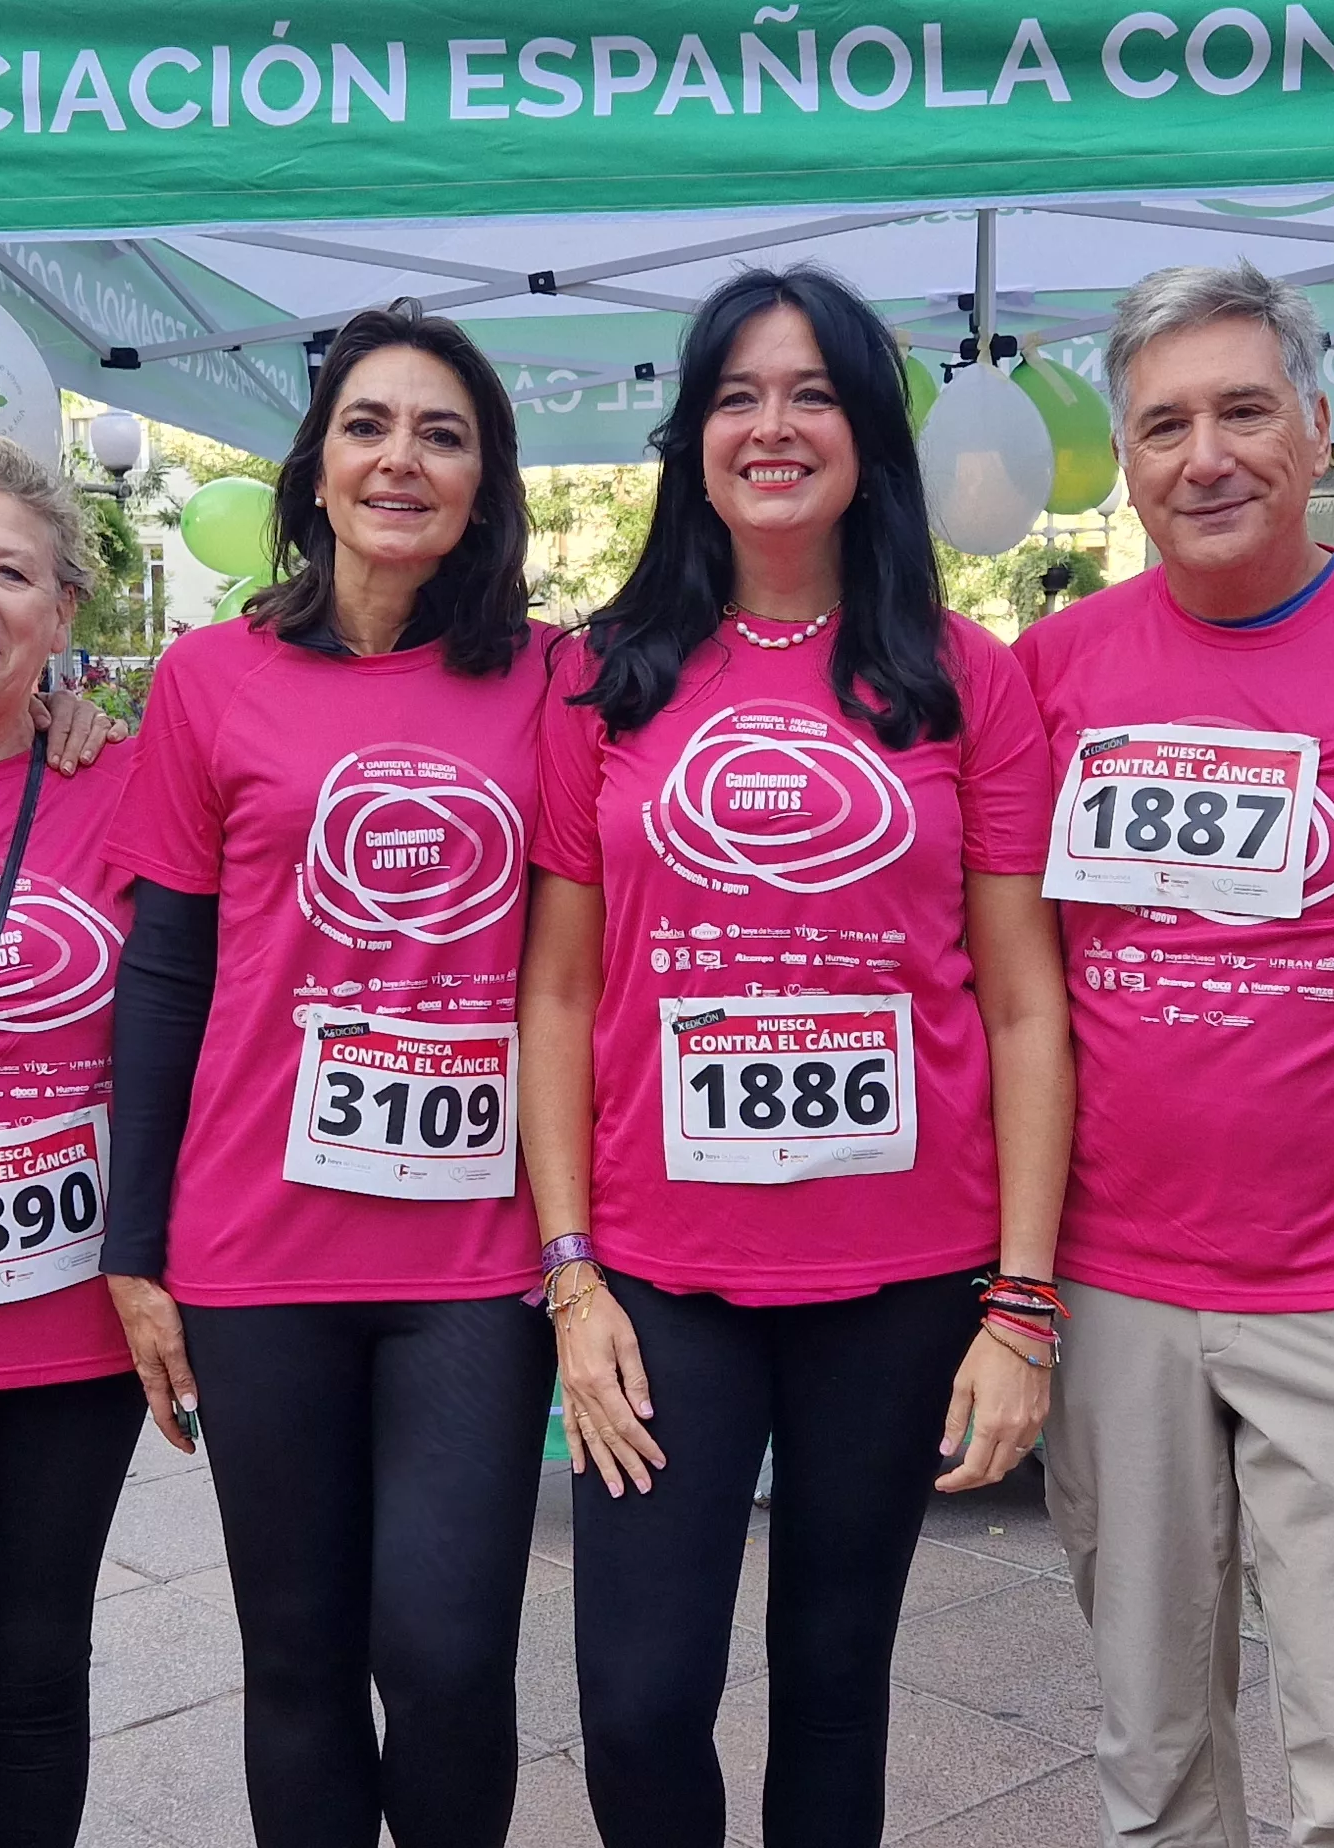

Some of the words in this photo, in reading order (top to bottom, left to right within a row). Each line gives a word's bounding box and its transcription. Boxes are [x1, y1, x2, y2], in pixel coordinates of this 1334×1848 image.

[449, 3, 1072, 120] ESPAÑOLA
[1157, 745, 1216, 762] HUESCA
[725, 771, 808, 789] Caminemos
[1091, 759, 1169, 777] CONTRA
[1174, 762, 1198, 780] EL
[1202, 762, 1286, 785] CÁNCER
[729, 790, 801, 811] JUNTOS
[1082, 785, 1286, 859] 1887
[365, 828, 445, 848] Caminemos
[372, 846, 441, 870] JUNTOS
[1269, 958, 1313, 968] URBAN
[757, 1018, 816, 1032] HUESCA
[397, 1040, 452, 1056] HUESCA
[689, 1035, 773, 1052] CONTRA
[778, 1035, 800, 1050] EL
[805, 1029, 886, 1050] CÁNCER
[332, 1044, 408, 1072] CONTRA
[414, 1057, 435, 1074] EL
[441, 1055, 500, 1074] CÁNCER
[689, 1058, 891, 1130] 1886
[317, 1072, 500, 1149] 3109
[23, 1143, 88, 1175] CÁNCER
